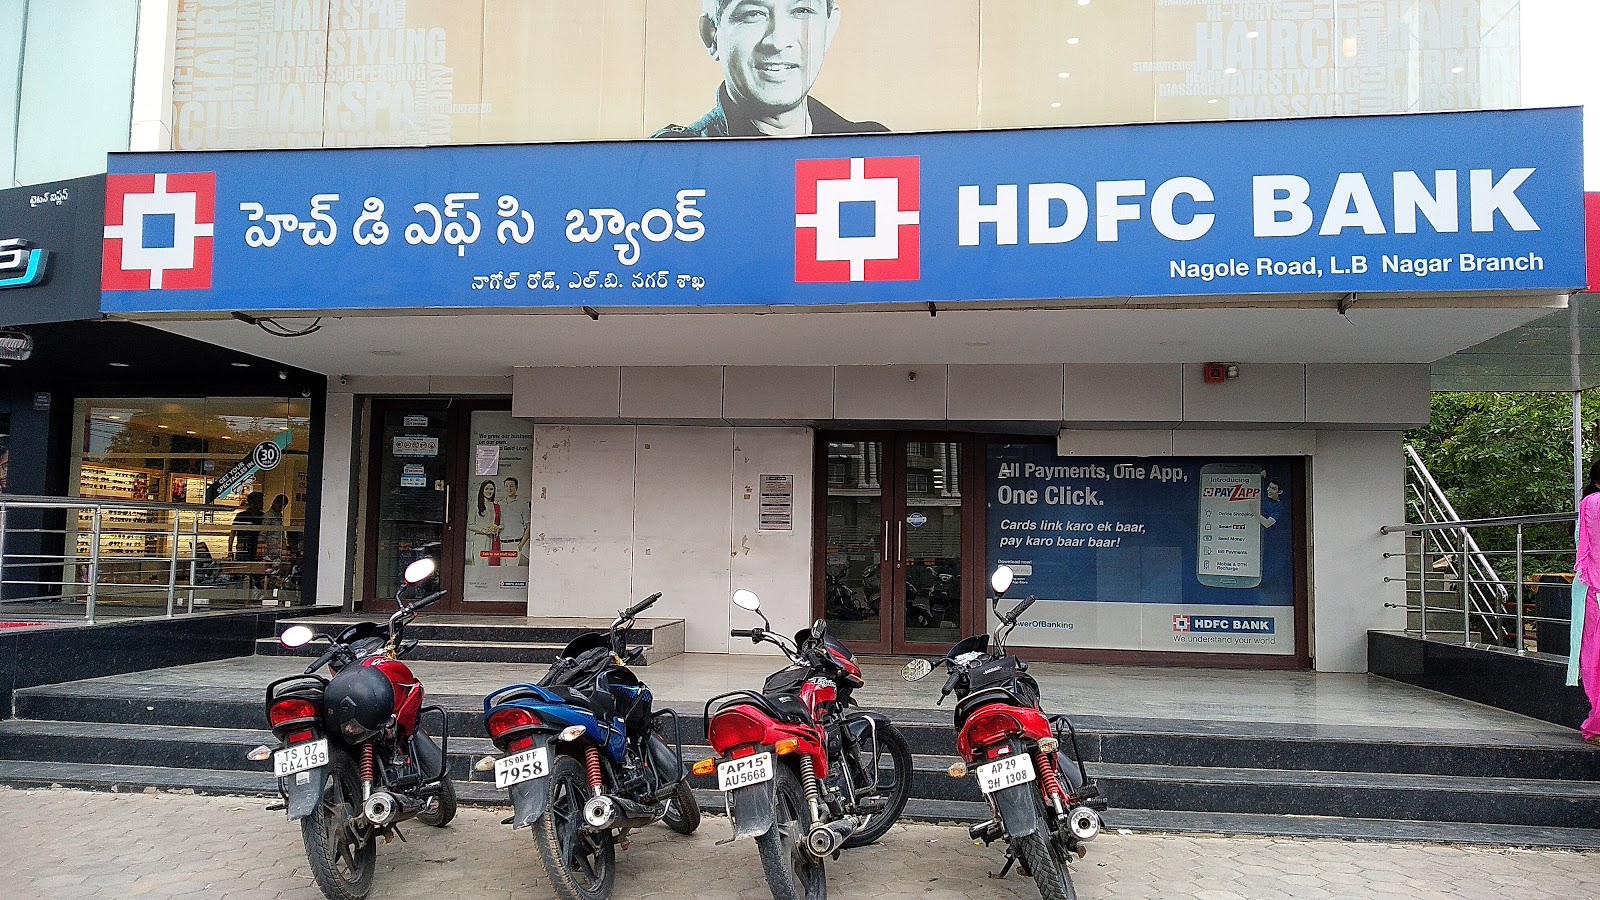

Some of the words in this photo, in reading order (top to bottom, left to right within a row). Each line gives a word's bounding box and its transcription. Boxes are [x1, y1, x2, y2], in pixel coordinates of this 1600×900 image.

[259, 27, 447, 67] HAIRSTYLING
[1214, 69, 1361, 96] HAIRSTYLING
[256, 81, 417, 133] HAIRSPA
[958, 176, 1216, 246] HDFC
[1253, 168, 1541, 238] BANK
[240, 194, 340, 247] హెచ్
[353, 197, 389, 245] డి
[405, 192, 481, 257] ఎఫ్
[497, 194, 535, 245] సి
[565, 189, 706, 266] బ్యాంక్
[1170, 259, 1250, 282] Nagole
[1256, 257, 1323, 278] Road,
[1330, 256, 1368, 275] L.B
[1382, 255, 1453, 277] Nagar
[1459, 253, 1544, 272] Branch
[471, 271, 520, 290] నాగోల్
[631, 270, 669, 289] నగర్
[676, 274, 705, 291] శాఖ
[260, 448, 275, 460] 30
[998, 463, 1020, 478] All
[1025, 464, 1111, 481] Payments,
[1114, 464, 1145, 479] One
[1150, 464, 1188, 482] App,
[998, 485, 1038, 504] One
[1045, 485, 1104, 505] Click.
[1000, 519, 1037, 531] Cards
[1040, 519, 1062, 531] link
[1066, 520, 1094, 532] karo
[1097, 521, 1113, 532] ek
[1115, 521, 1146, 535] baar,
[1000, 537, 1023, 548] pay
[1026, 535, 1053, 547] karo
[1056, 536, 1085, 547] baar
[1088, 537, 1121, 548] baar!
[1017, 620, 1074, 630] werOfBanking
[1194, 619, 1229, 629] HDFC
[1232, 620, 1269, 630] BANK
[1173, 634, 1186, 642] We
[1187, 635, 1232, 643] understand
[284, 749, 298, 761] TS
[304, 743, 317, 755] 07
[281, 752, 325, 773] GA4199
[503, 758, 514, 767] TS
[500, 761, 542, 784] 7958
[1006, 770, 1027, 784] 1308
